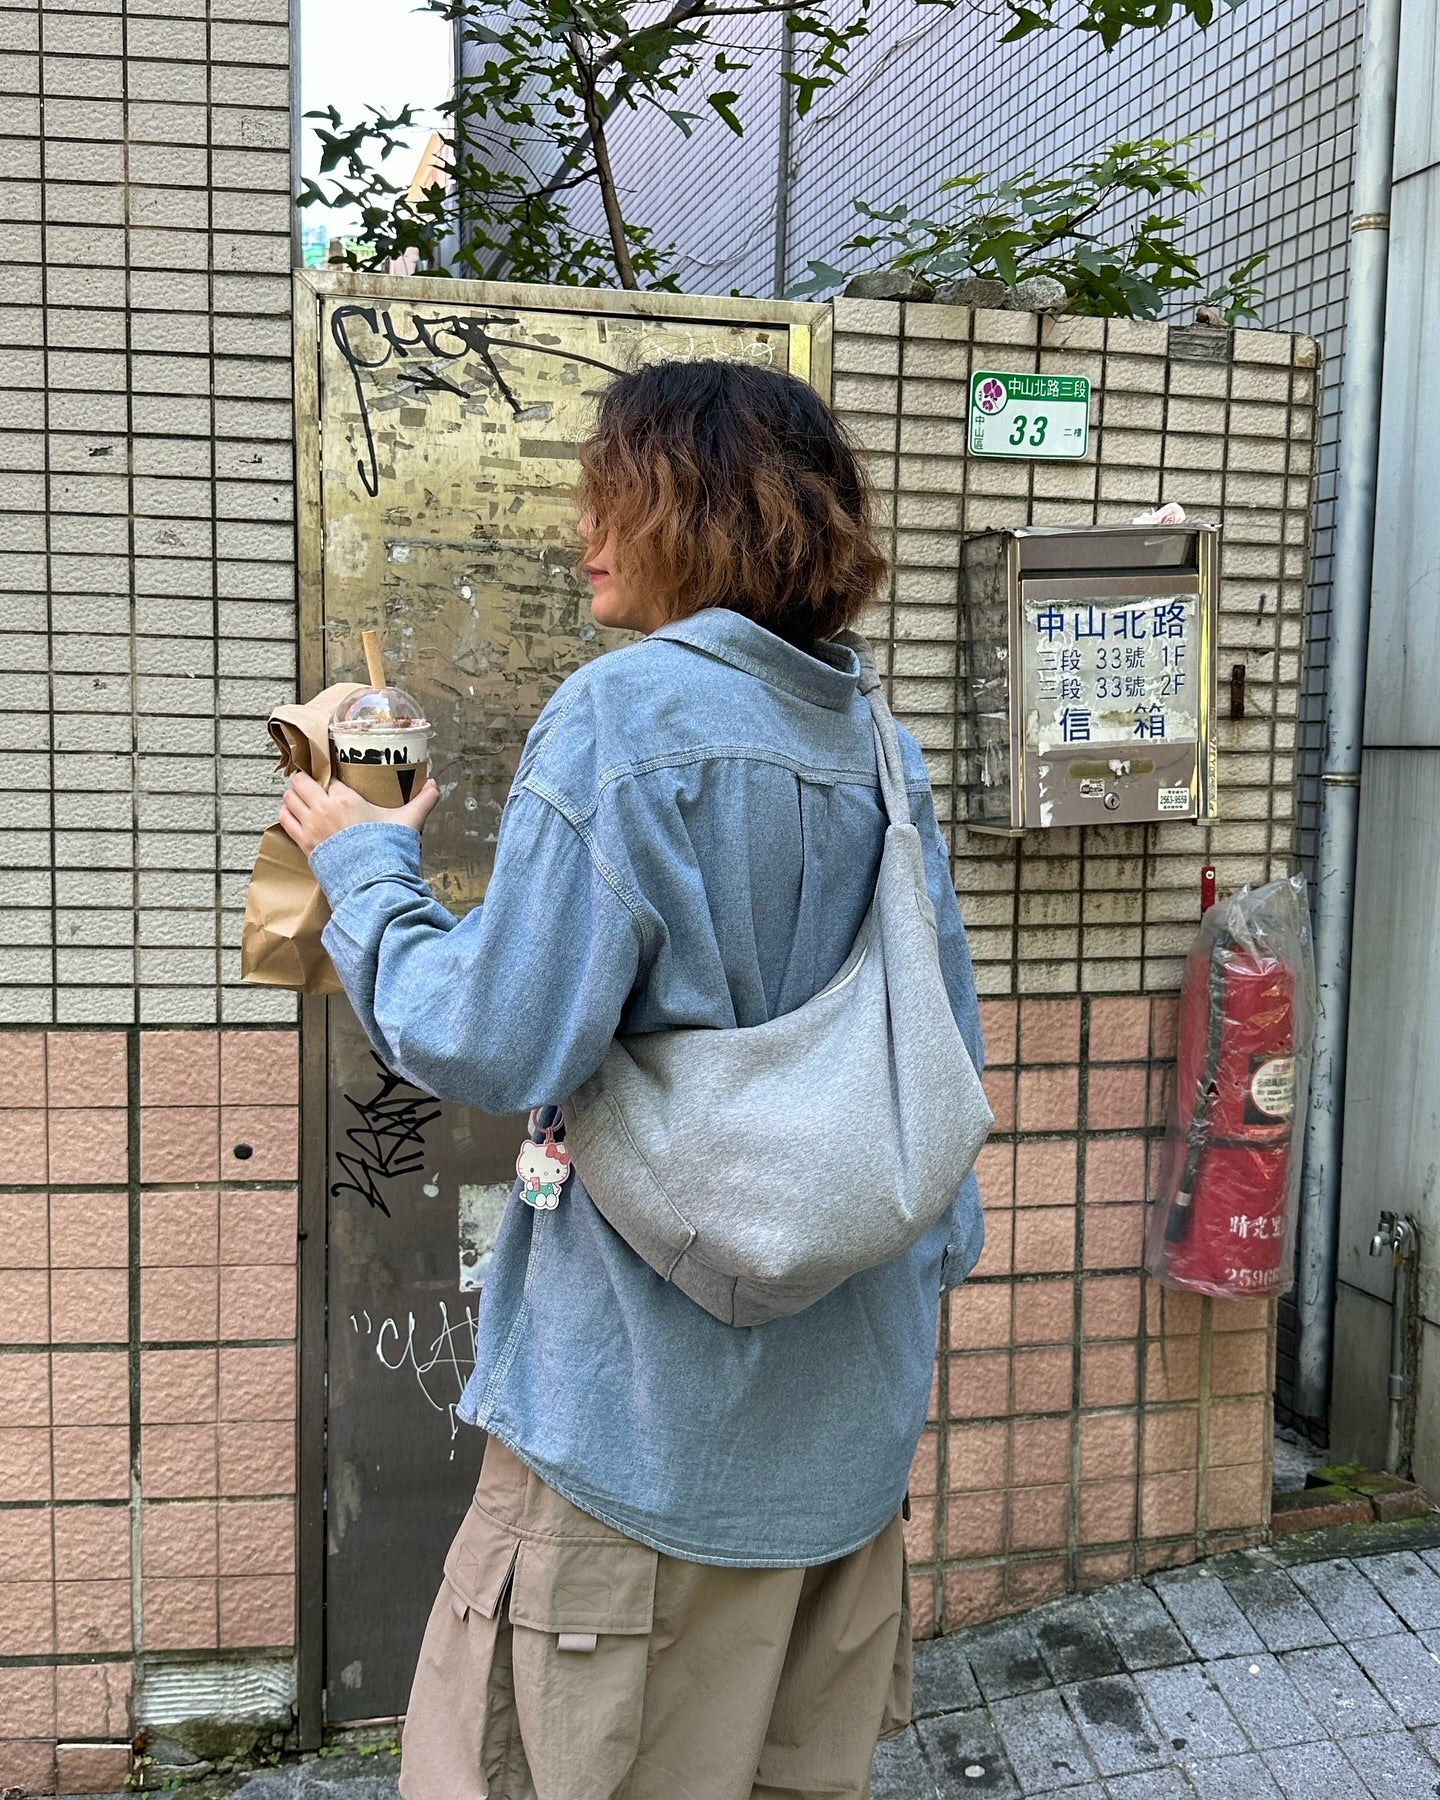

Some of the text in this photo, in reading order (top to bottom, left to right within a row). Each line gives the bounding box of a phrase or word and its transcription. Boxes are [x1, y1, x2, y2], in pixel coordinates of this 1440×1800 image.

[1008, 377, 1086, 398] 中山北路三段
[1009, 415, 1048, 447] 33
[1037, 600, 1186, 642] 中山北路
[1038, 645, 1186, 671] 三段 33號 1F
[1038, 674, 1186, 700] 三段 33號 2F
